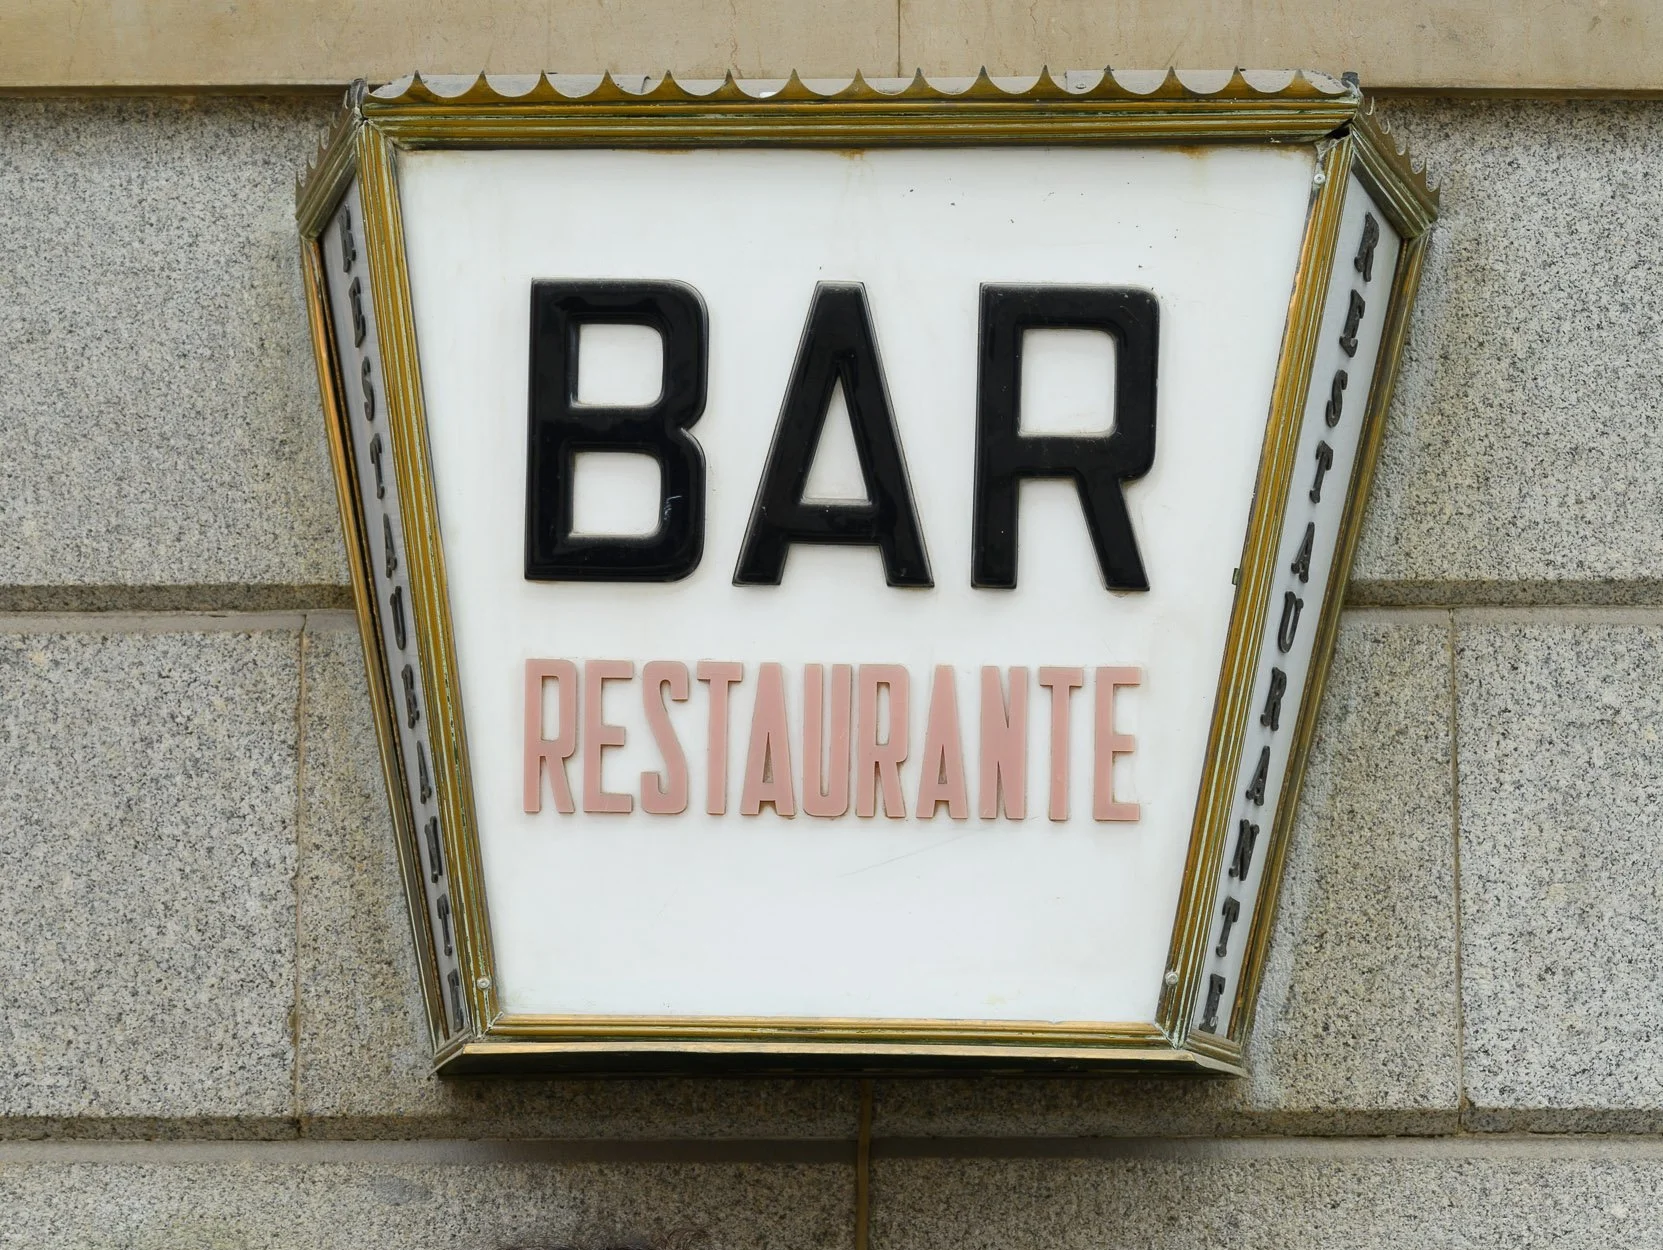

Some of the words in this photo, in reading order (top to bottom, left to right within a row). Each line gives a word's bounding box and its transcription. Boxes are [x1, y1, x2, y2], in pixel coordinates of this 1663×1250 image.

[524, 276, 1161, 592] BAR
[524, 657, 1144, 823] RESTAURANTE
[1199, 212, 1380, 1033] RESTAURANTE
